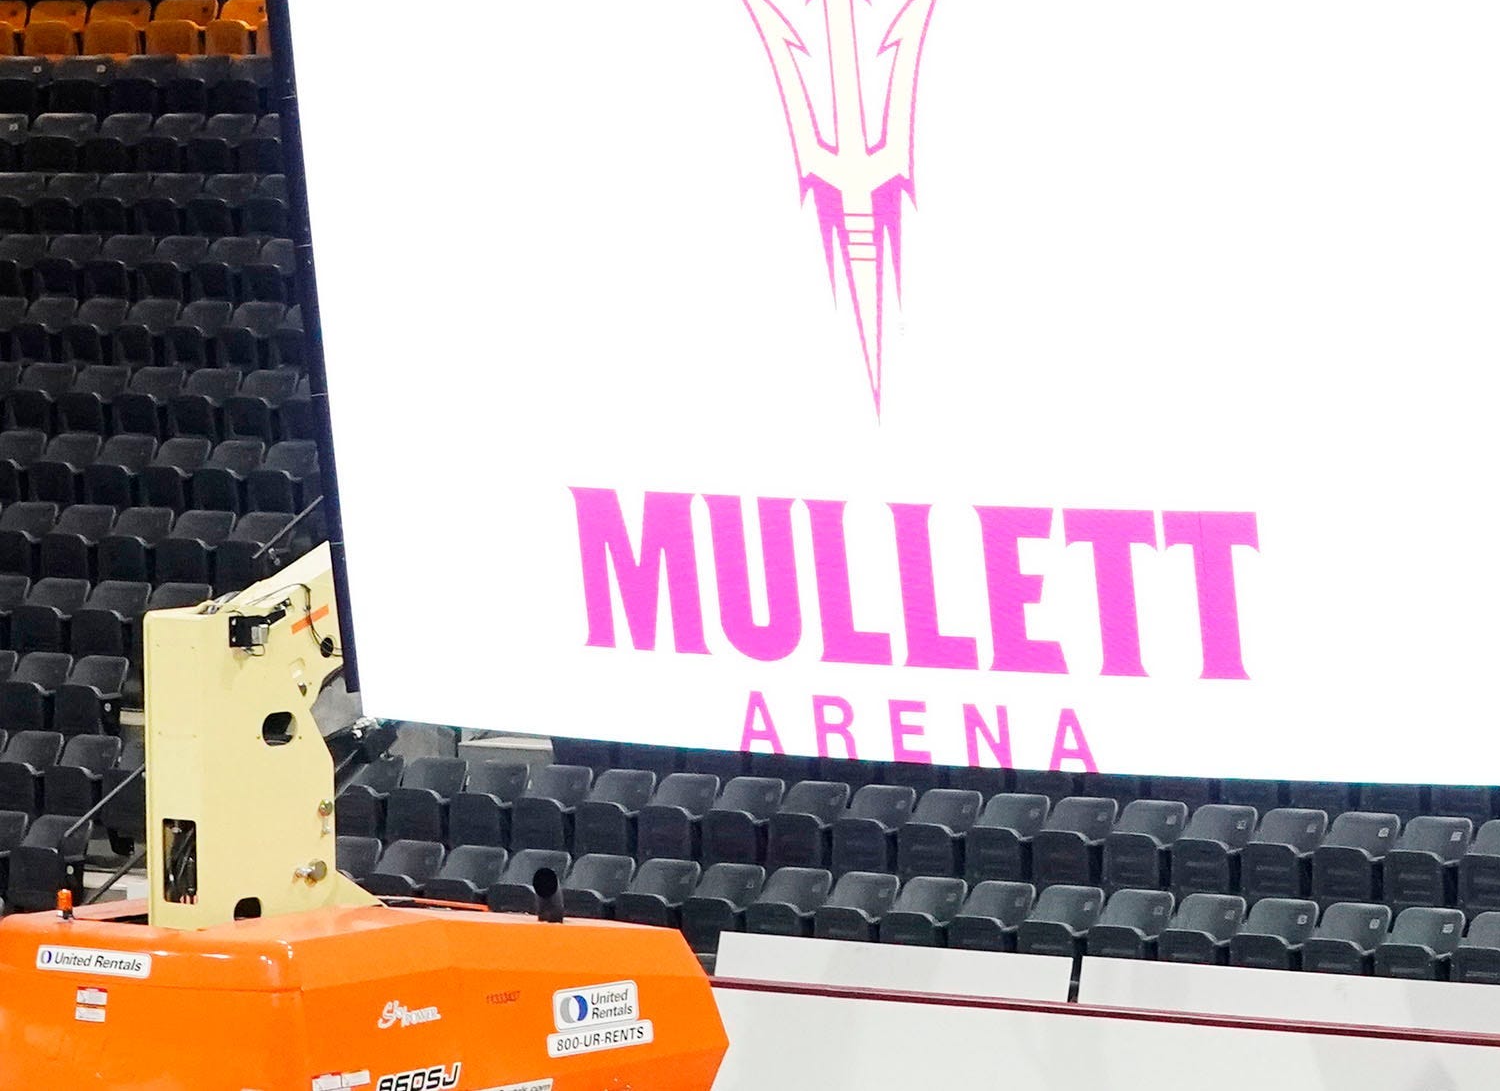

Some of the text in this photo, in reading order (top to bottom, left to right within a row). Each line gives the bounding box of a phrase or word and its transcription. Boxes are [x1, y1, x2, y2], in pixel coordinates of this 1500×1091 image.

[567, 485, 1261, 681] MULLETT
[739, 689, 1101, 774] ARENA
[54, 951, 142, 972] United Rentals
[590, 988, 629, 1006] United
[592, 1004, 633, 1020] Rentals
[556, 1025, 645, 1052] 800-UR-RENTS
[378, 1064, 460, 1091] 860SJ
